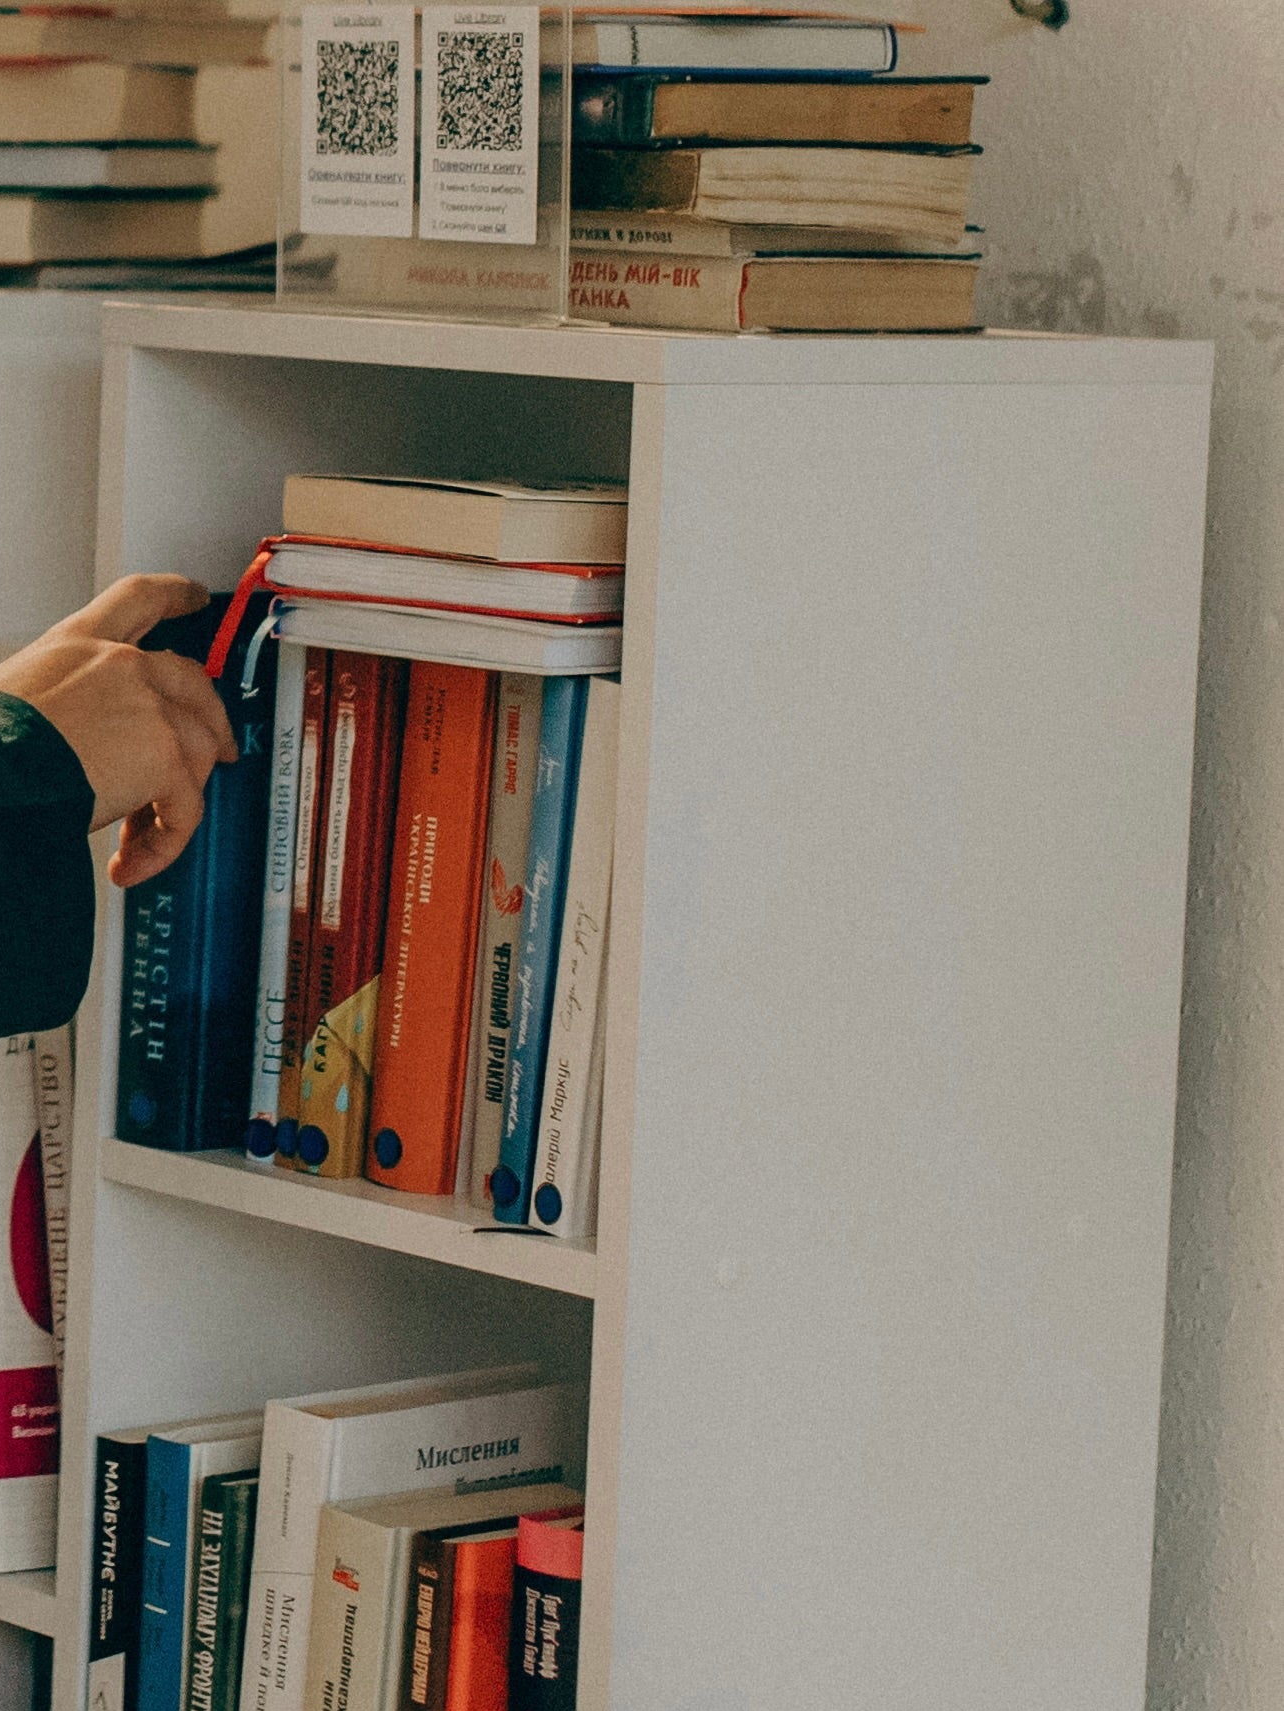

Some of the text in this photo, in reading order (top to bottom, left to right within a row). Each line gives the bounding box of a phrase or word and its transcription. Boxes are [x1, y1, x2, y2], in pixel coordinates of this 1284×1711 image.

[272, 726, 295, 894] СТЕПОВИЙ ВОВК
[419, 815, 439, 904] ПРИГОДИ
[129, 906, 152, 1039] ГЕННА
[146, 893, 173, 1063] КРІСТІН
[389, 813, 423, 1048] УКРАЇНСЬКОЇ ЛІТЕРАТУРИ
[485, 941, 512, 1104] ЧЕРВОНИЙ ДРАКОН
[40, 1053, 67, 1190] ЦАРСТВО
[545, 1057, 571, 1185] алерій Маркус
[416, 1437, 520, 1471] Мислення
[101, 1458, 122, 1583] МАЙБУТНЄ
[202, 1508, 224, 1537] НА
[195, 1539, 222, 1651] ЗАХІДНОМУ
[262, 1588, 276, 1660] швидке
[275, 1593, 296, 1690] Мислення
